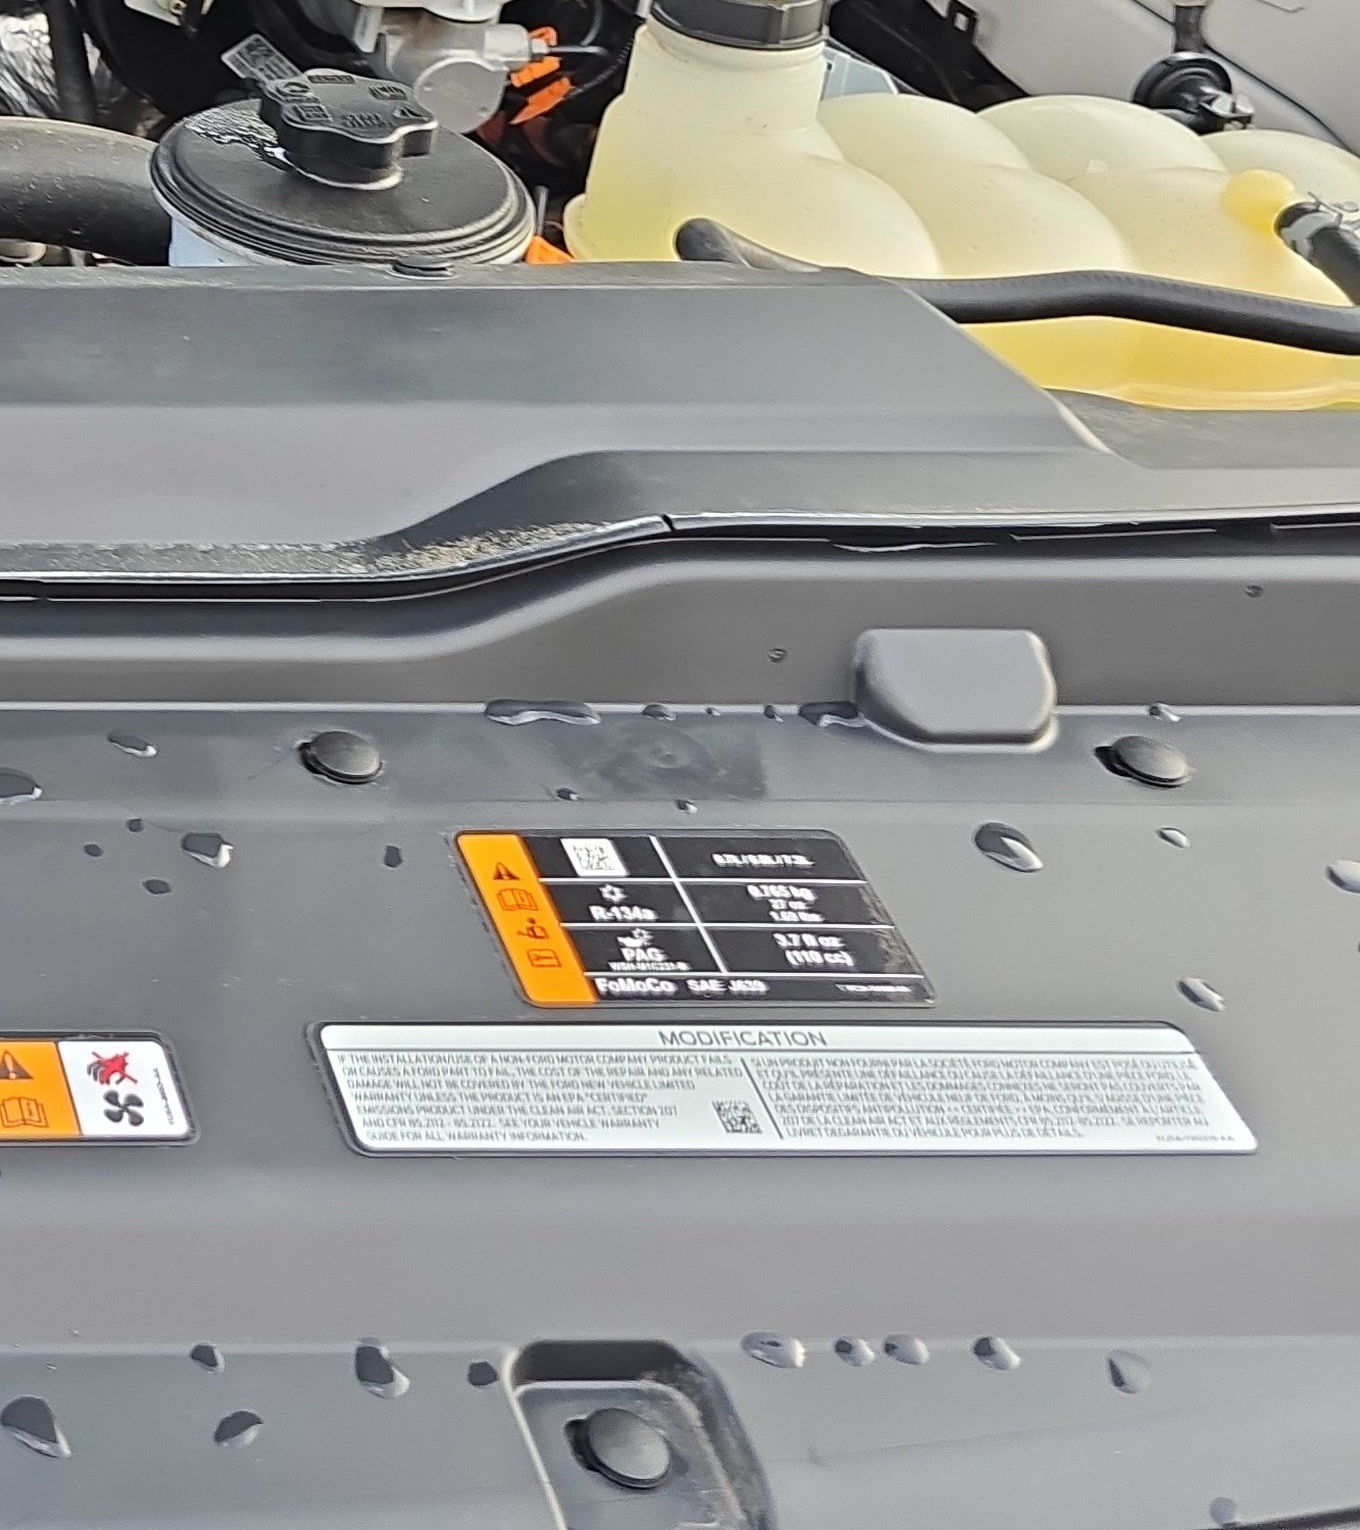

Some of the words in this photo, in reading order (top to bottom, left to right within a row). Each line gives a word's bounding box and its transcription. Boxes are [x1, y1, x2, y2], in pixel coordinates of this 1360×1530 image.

[588, 905, 659, 921] R-134a
[621, 948, 668, 962] PAG
[594, 978, 679, 995] FoMoCo
[686, 979, 728, 994] SAE
[657, 1031, 828, 1047] MODIFICATION
